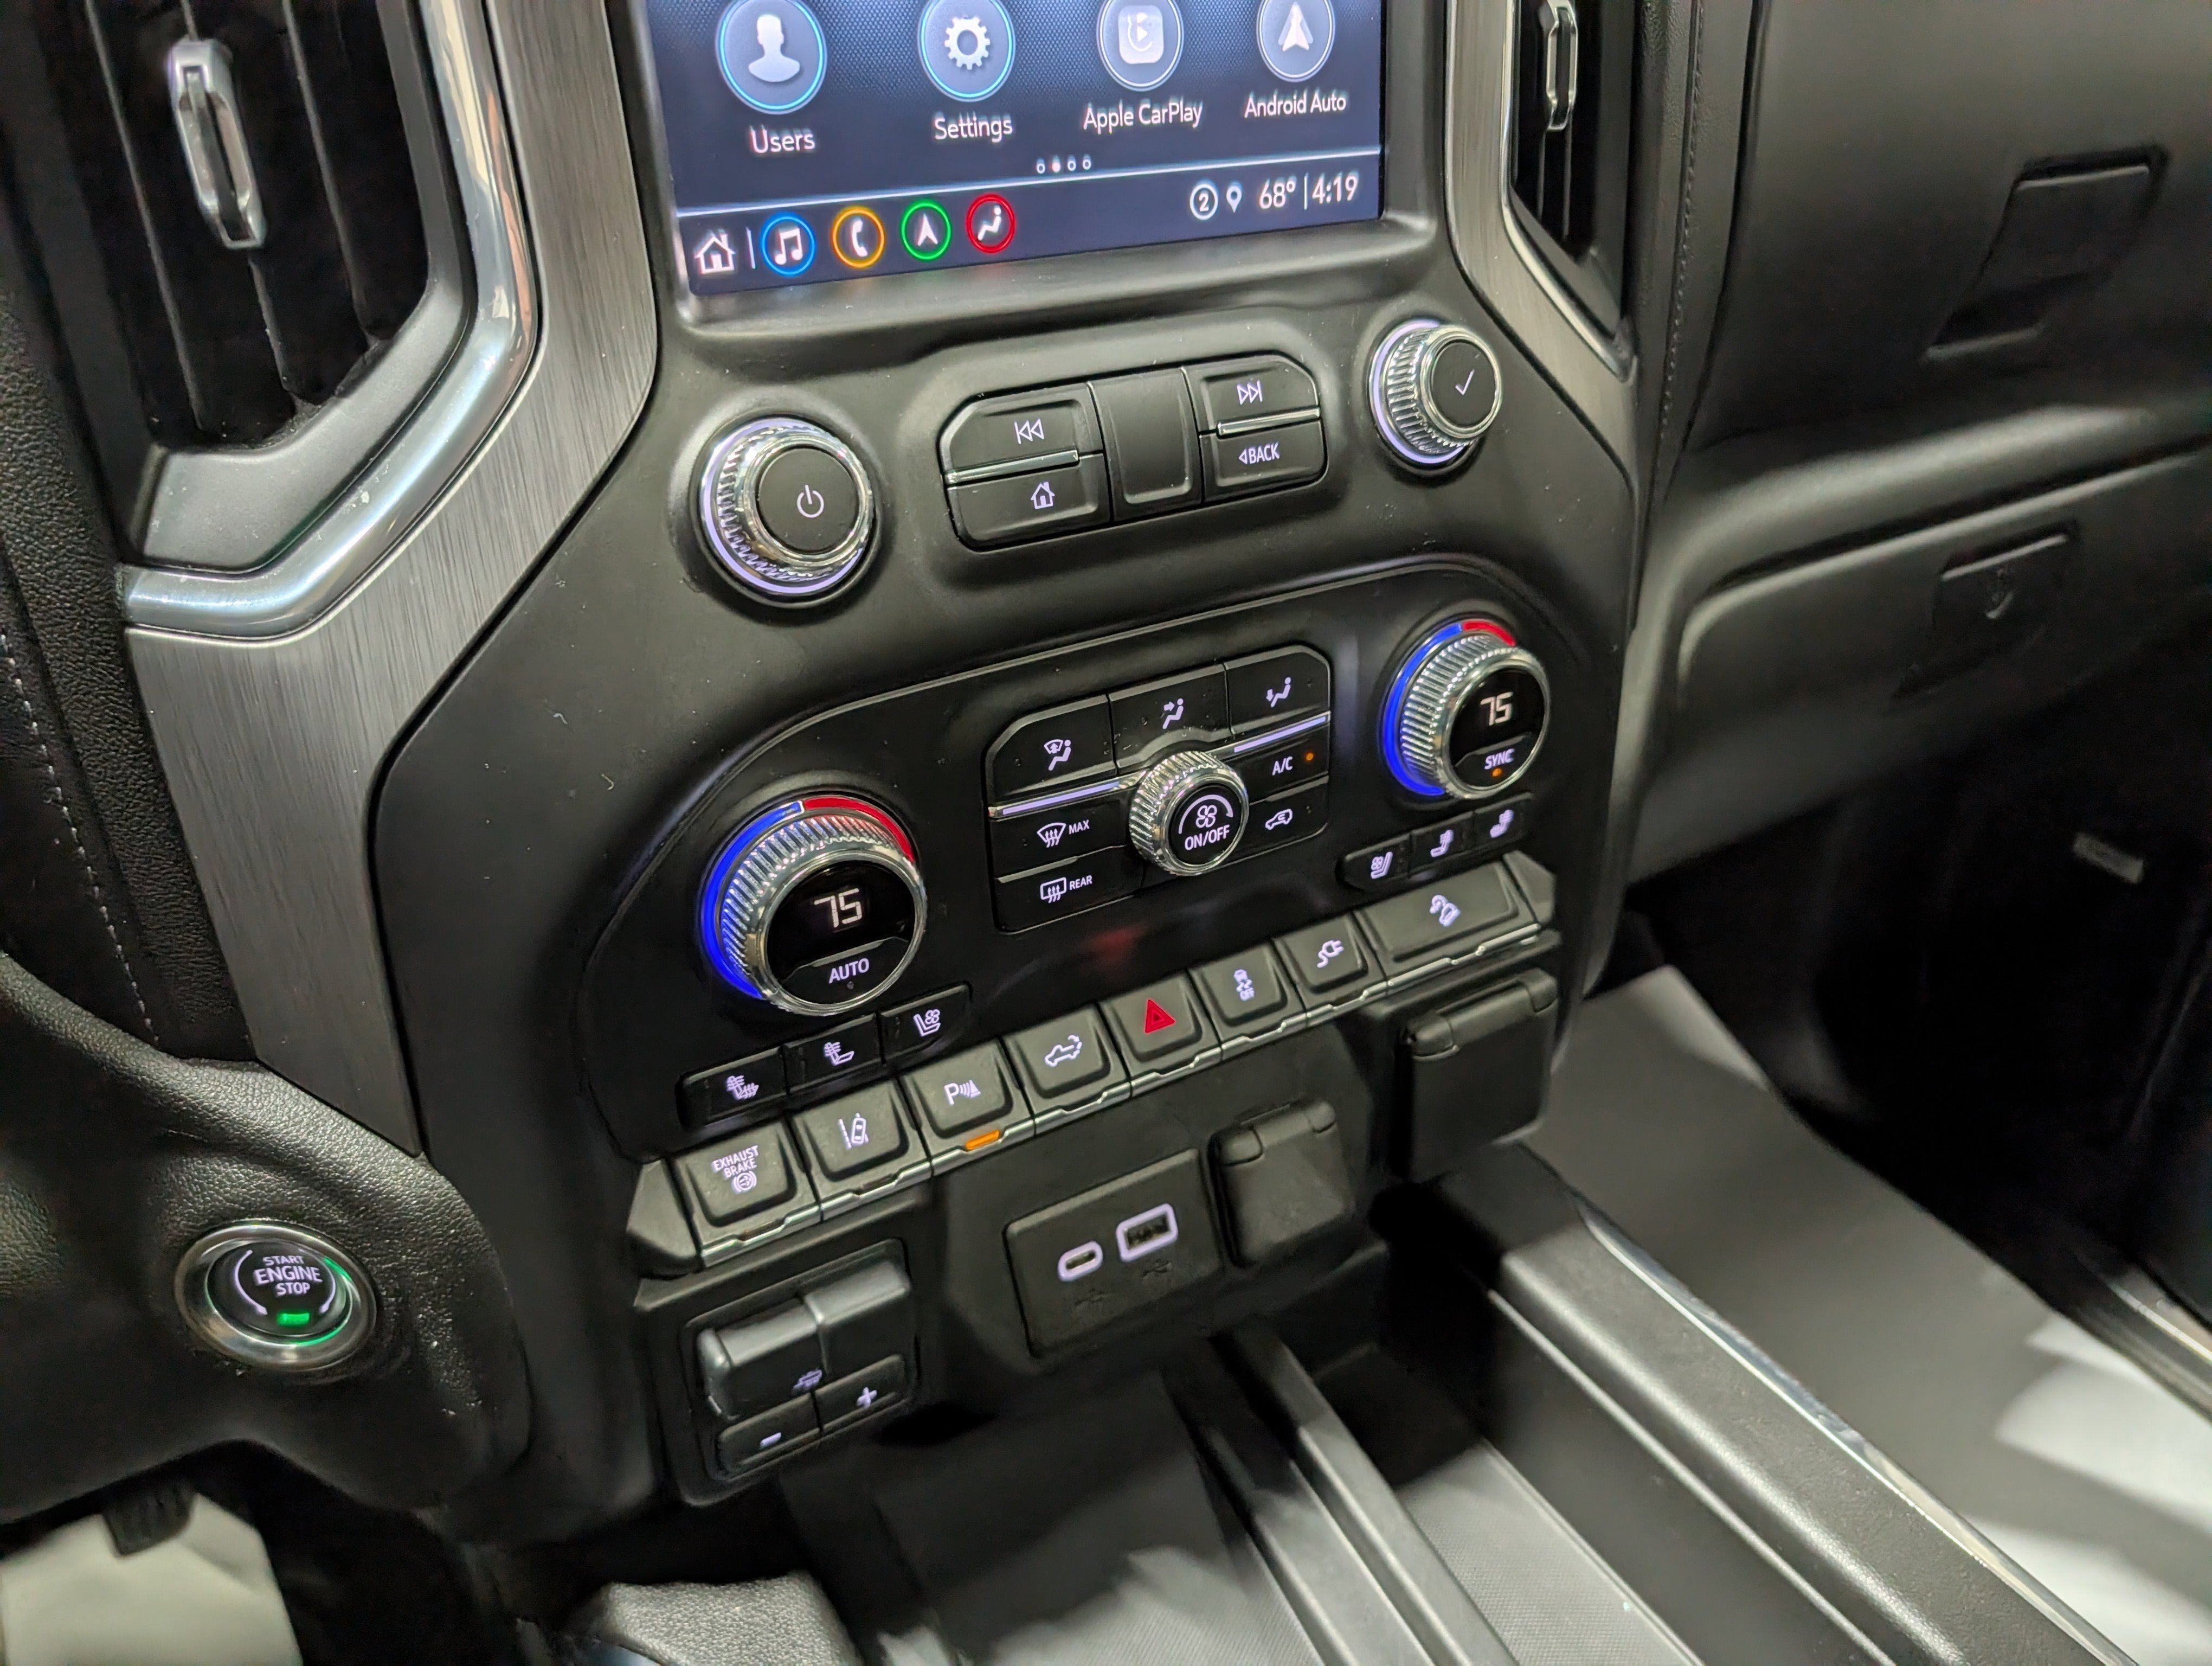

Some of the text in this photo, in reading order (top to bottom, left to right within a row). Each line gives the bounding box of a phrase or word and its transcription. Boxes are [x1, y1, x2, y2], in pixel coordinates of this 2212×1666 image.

[1245, 92, 1347, 118] Android Auto
[934, 113, 1013, 142] Settings
[1083, 101, 1203, 134] Apple CarPlay
[750, 127, 815, 154] Users
[1311, 174, 1359, 204] 4:19
[1198, 192, 1209, 212] 2
[1248, 442, 1280, 464] BACK
[1481, 692, 1513, 726] 75
[1272, 756, 1294, 776] A/C
[1484, 748, 1514, 770] SYNC
[1068, 819, 1090, 835] MAX
[1184, 824, 1231, 851] ON/OFF
[1069, 875, 1093, 891] REAR
[814, 888, 863, 928] 75
[828, 958, 870, 984] AUTO
[1240, 987, 1255, 1001] OFF
[713, 1145, 759, 1172] EXHAUST
[724, 1159, 757, 1178] BRAKE
[262, 1255, 305, 1266] START
[254, 1266, 323, 1286] ENGINE
[275, 1281, 311, 1297] STOP
